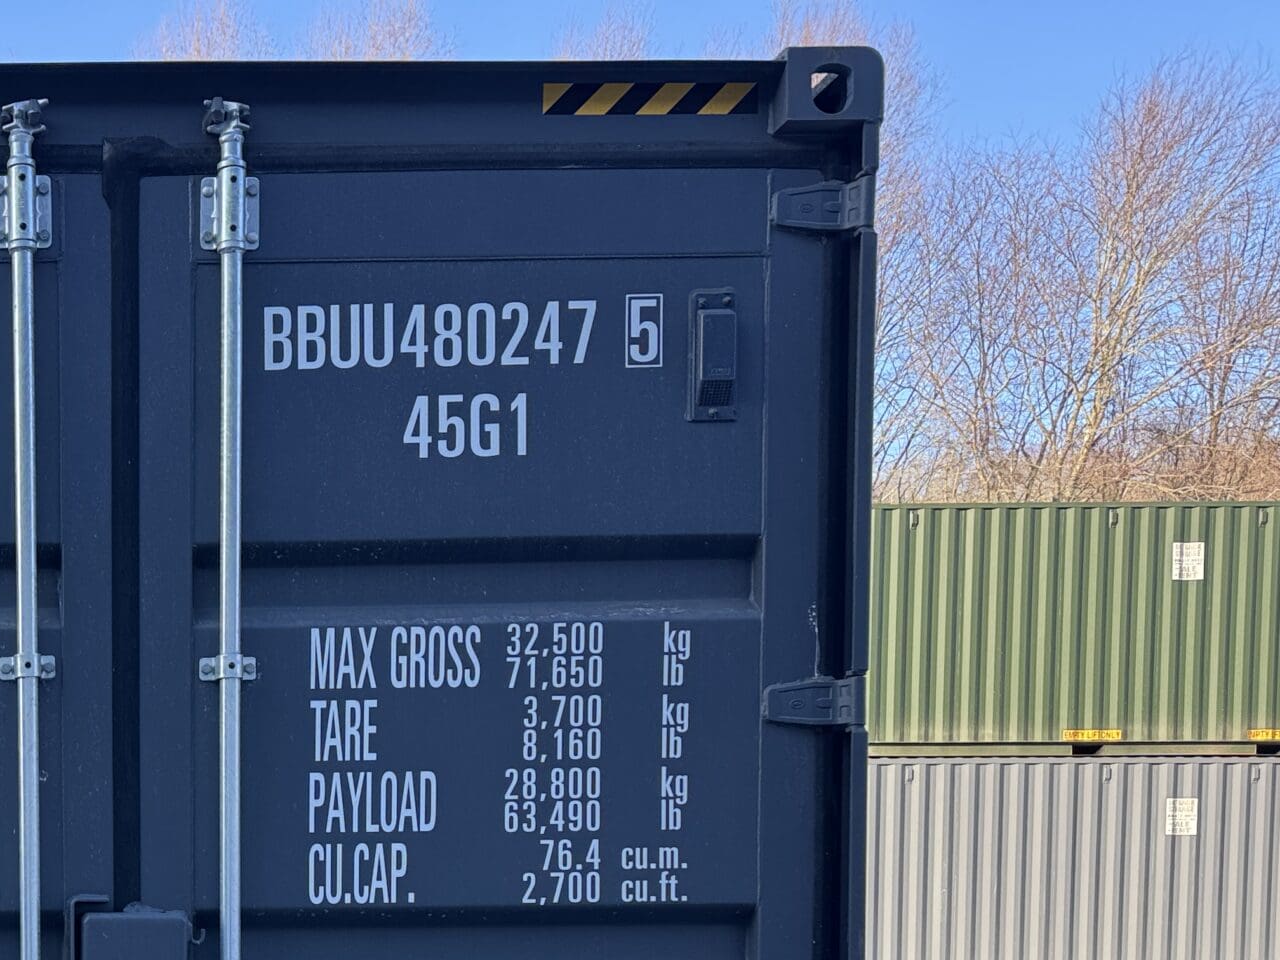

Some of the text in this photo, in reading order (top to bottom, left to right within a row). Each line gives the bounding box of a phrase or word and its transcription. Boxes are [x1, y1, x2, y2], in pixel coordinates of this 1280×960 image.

[263, 298, 659, 371] BBUU480247 5
[403, 393, 527, 459] 45G1
[310, 620, 691, 690] MAX GROSS 32,500 kg
[506, 655, 684, 691] 71,650 lb
[310, 694, 690, 762] TARE 3,700 kg
[522, 727, 682, 763] 8,160 lb
[308, 766, 688, 833] PAYLOAD 28,800 kg
[504, 799, 682, 835] 63,490 lb
[308, 839, 688, 905] CU.CAP. 76.4 cu.m.
[522, 871, 688, 906] 2,700 cu.ft.
